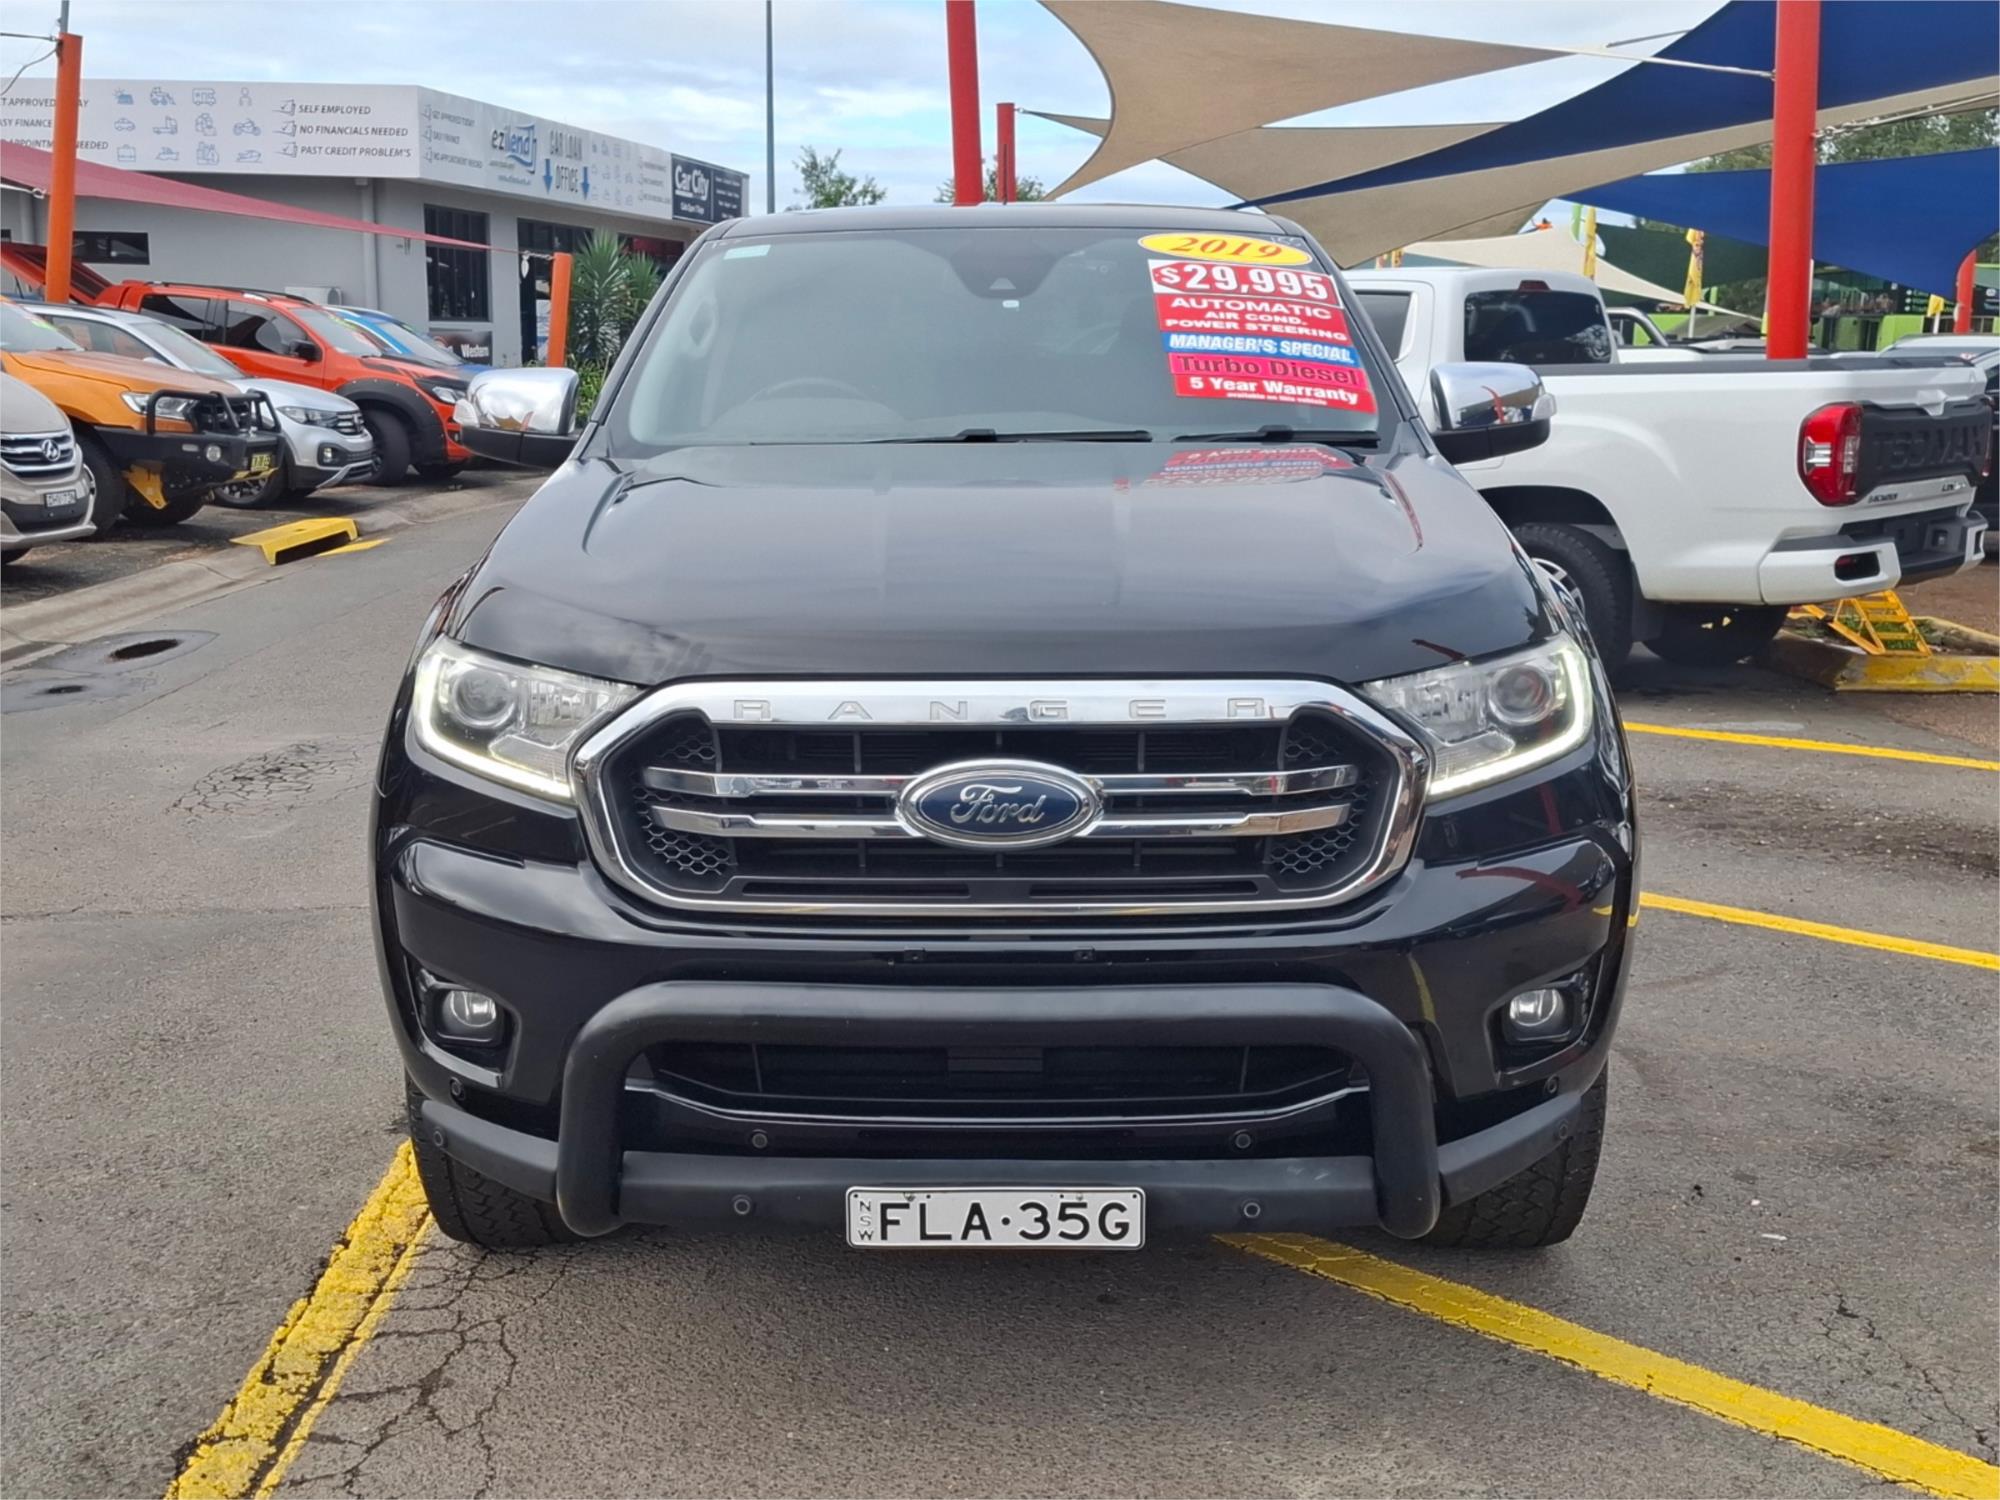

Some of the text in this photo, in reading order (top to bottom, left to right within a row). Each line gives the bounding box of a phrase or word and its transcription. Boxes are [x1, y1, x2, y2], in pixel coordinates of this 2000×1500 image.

[8, 97, 56, 107] APPROVED
[298, 104, 371, 115] SELF EMPLOYED
[15, 118, 52, 128] FINANCE
[299, 125, 409, 137] NO FINANCIALS NEEDED
[300, 146, 412, 158] PAST CREDIT PROBLEM'S
[1169, 236, 1284, 259] 2019
[1160, 263, 1329, 300] $29,995
[1170, 297, 1333, 320] AUTOMATIC
[1203, 311, 1309, 326] AIR COND.
[1164, 319, 1349, 341] POWER STEERING
[1168, 333, 1356, 365] MANAGER'S SPECIAL
[1177, 355, 1359, 386] Turbo Diesel
[1189, 377, 1359, 405] 5 Year Warranty
[733, 698, 1267, 721] RANGER
[949, 782, 1049, 825] Ford
[857, 1200, 875, 1241] NSW
